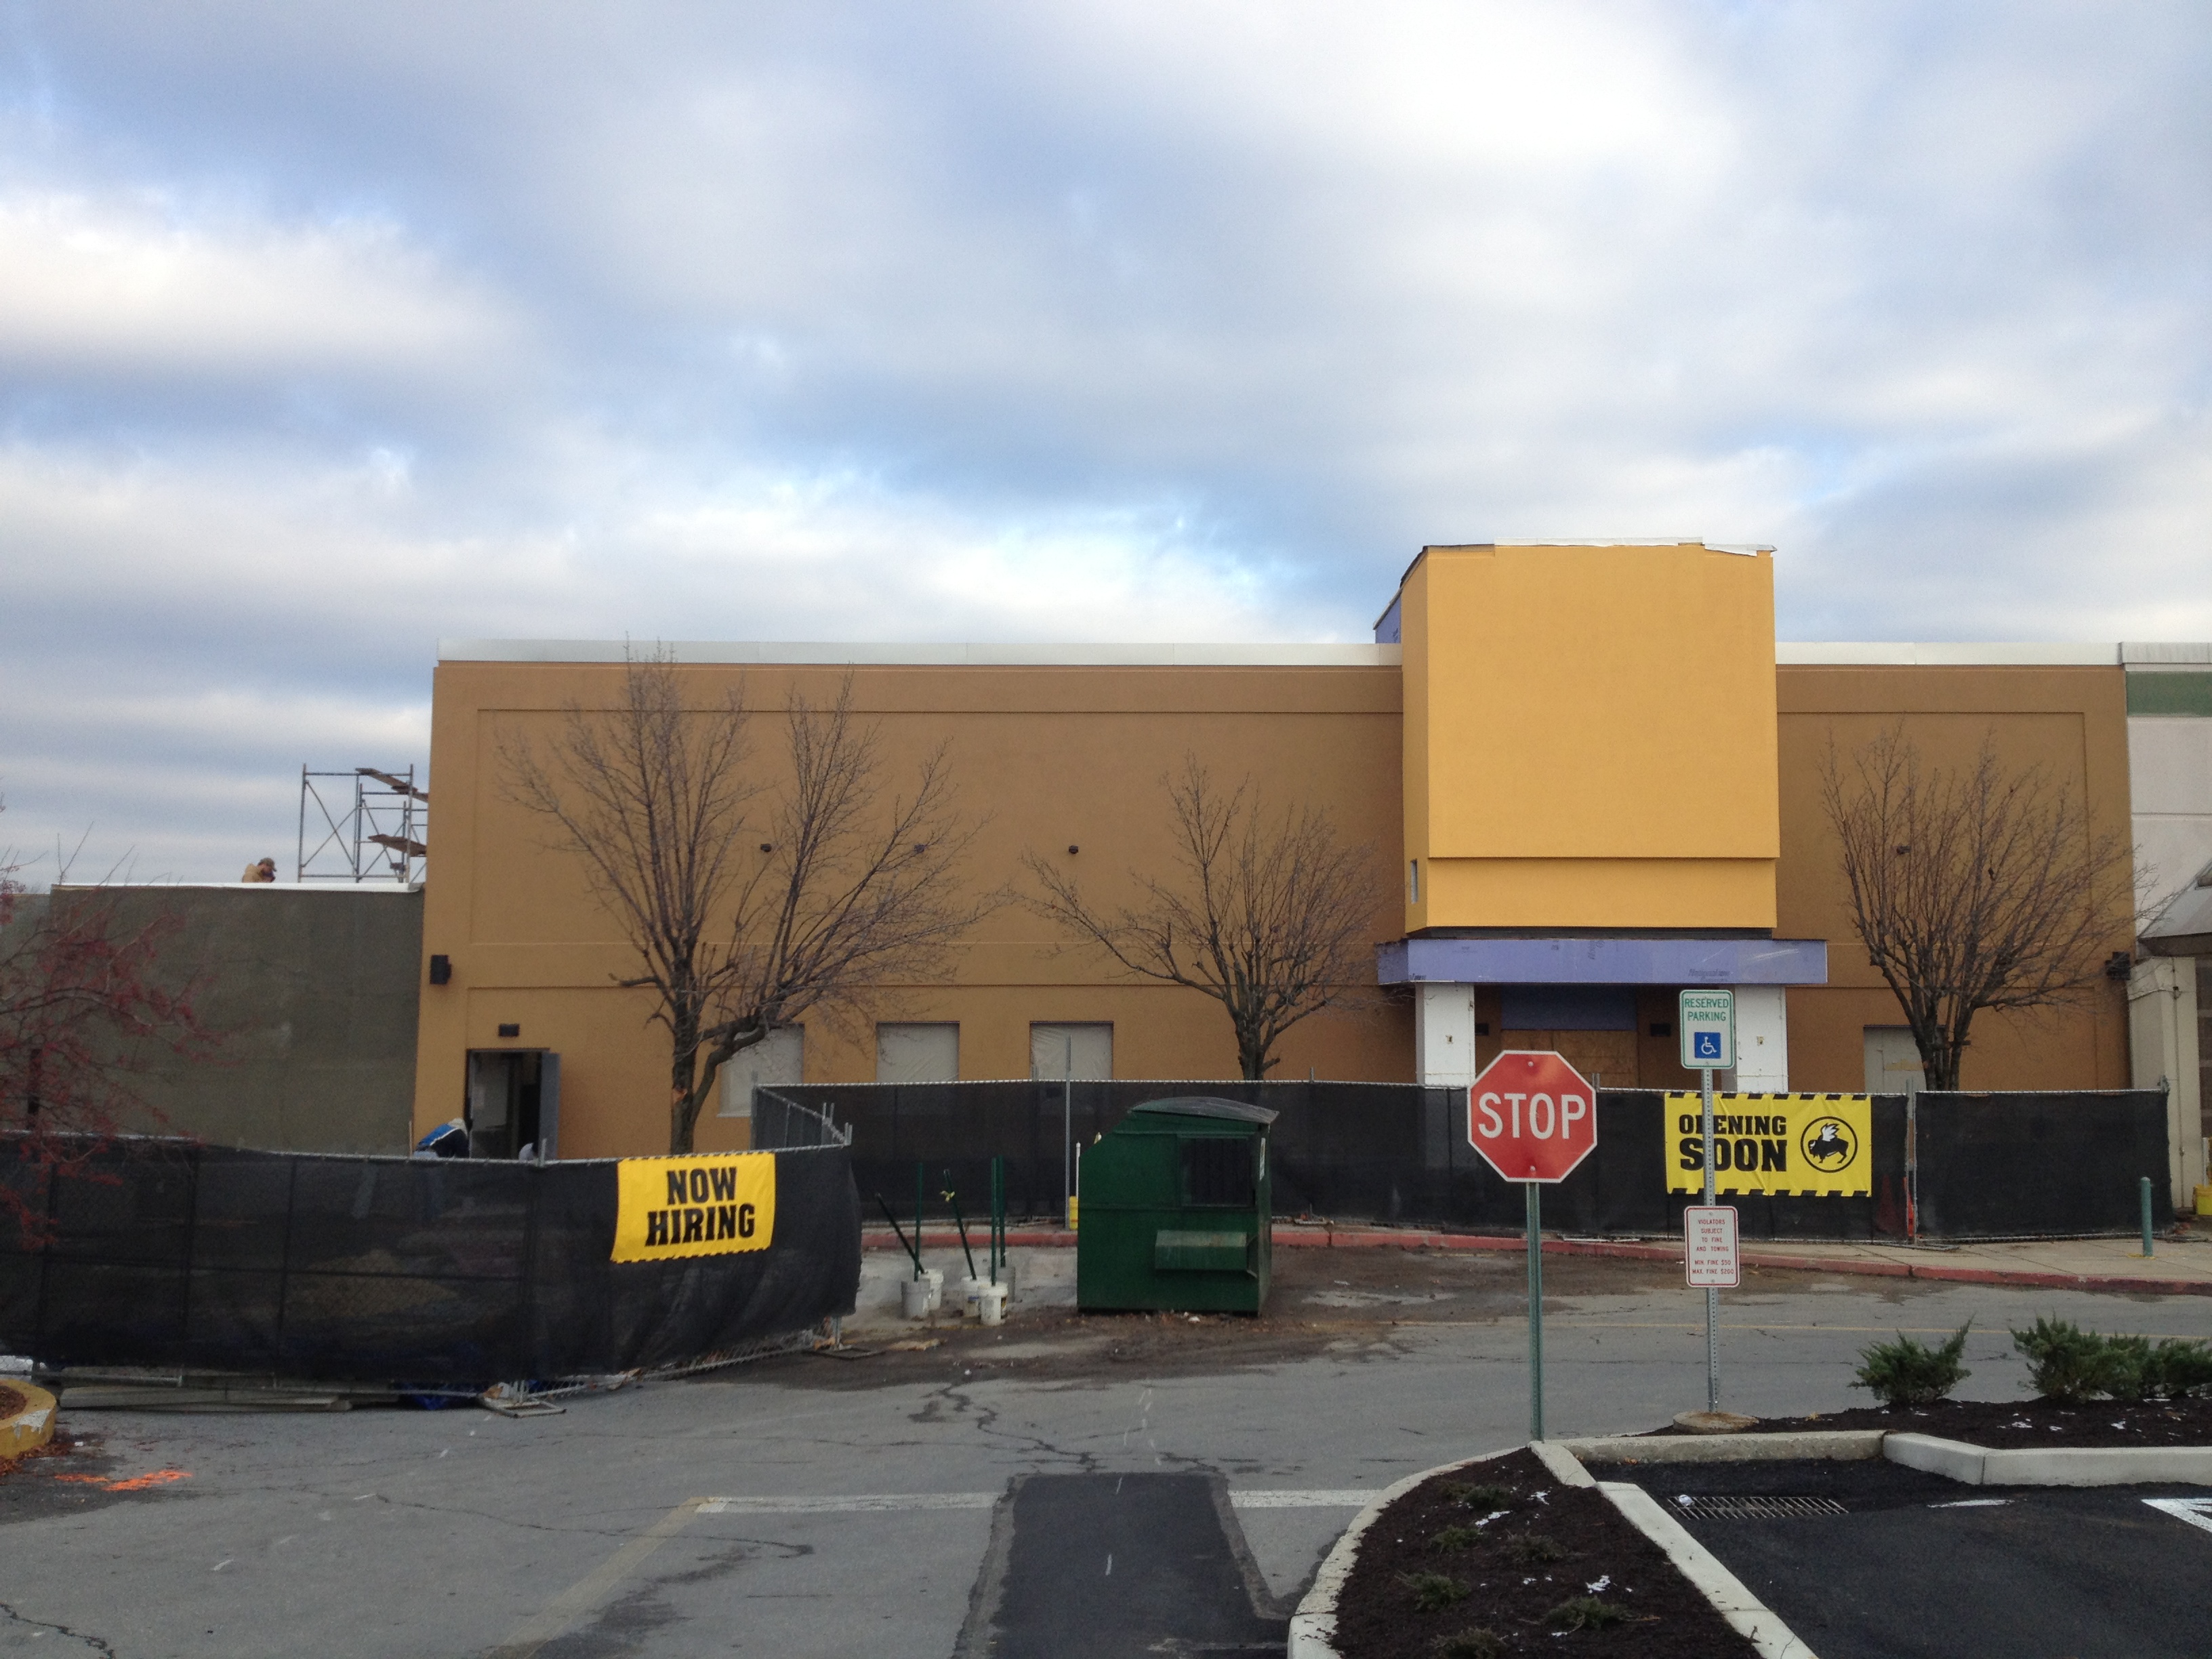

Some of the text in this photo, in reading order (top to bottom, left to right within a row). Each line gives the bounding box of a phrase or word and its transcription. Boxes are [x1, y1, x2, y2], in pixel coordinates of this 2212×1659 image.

[1684, 998, 1729, 1008] RESERVED
[1687, 1011, 1726, 1021] PARKING
[1478, 1092, 1586, 1140] STOP
[1679, 1137, 1787, 1172] SOON
[666, 1166, 737, 1206] NOW
[645, 1203, 755, 1247] HIRING
